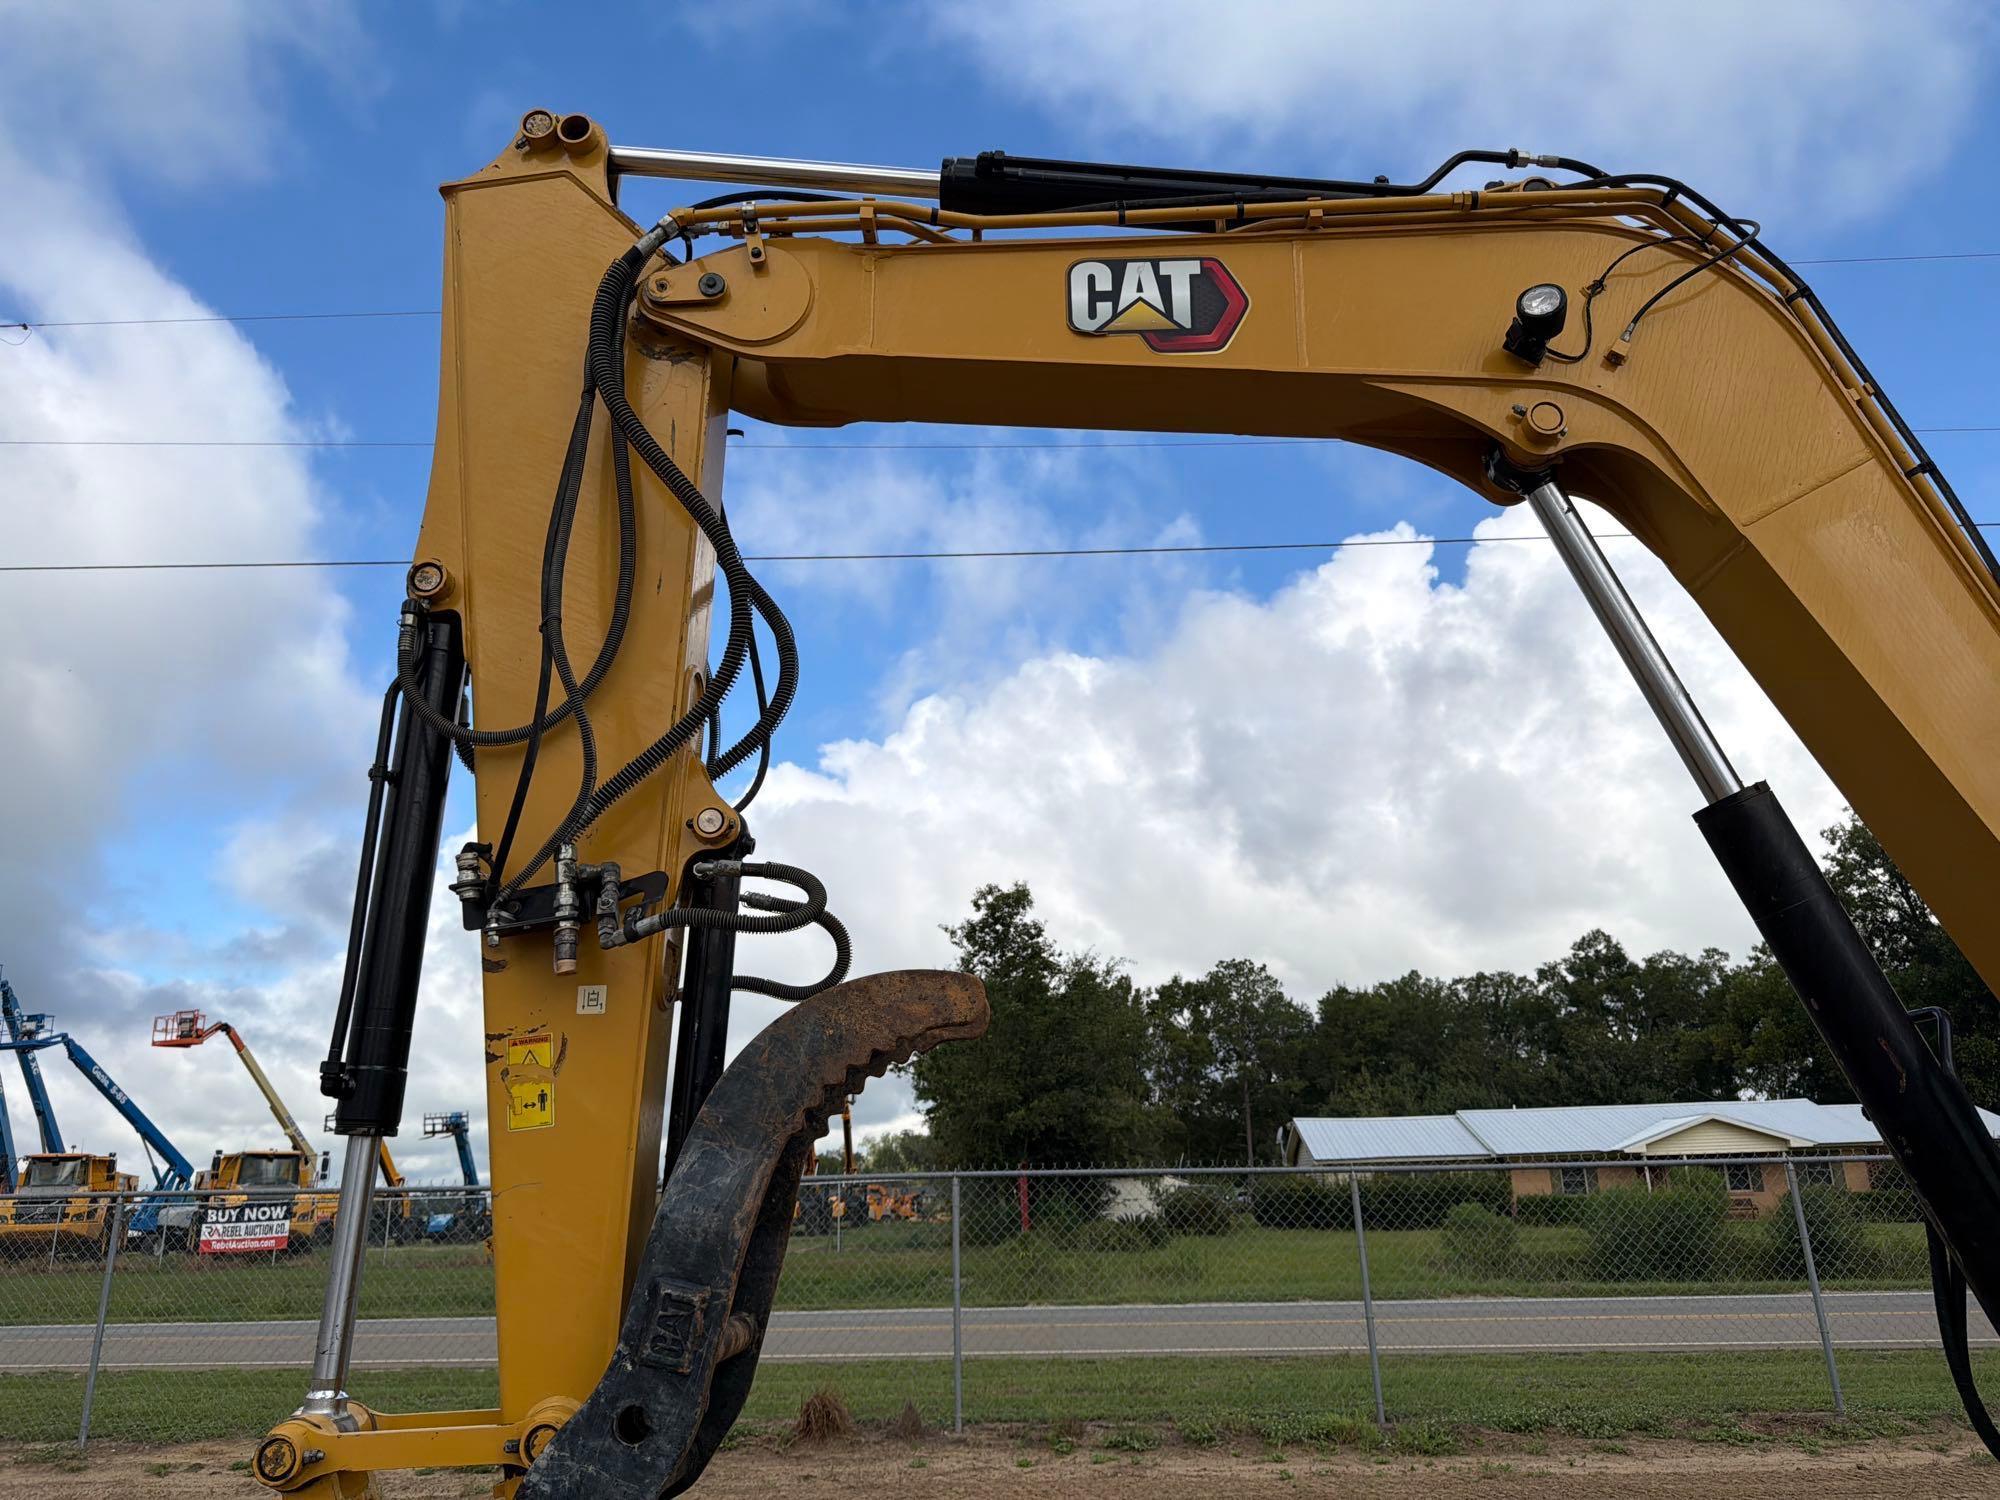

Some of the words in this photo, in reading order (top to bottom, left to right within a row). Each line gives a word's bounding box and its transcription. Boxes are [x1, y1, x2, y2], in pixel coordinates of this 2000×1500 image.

[1070, 260, 1200, 331] CAT
[518, 1036, 549, 1045] WARNING
[92, 1065, 109, 1088] Genie
[207, 1208, 241, 1222] BUY
[244, 1205, 288, 1221] NOW
[222, 1225, 242, 1238] REBEL
[244, 1223, 274, 1236] AUCTION
[211, 1239, 276, 1250] RebelAuction.com
[650, 1293, 697, 1358] CAT
